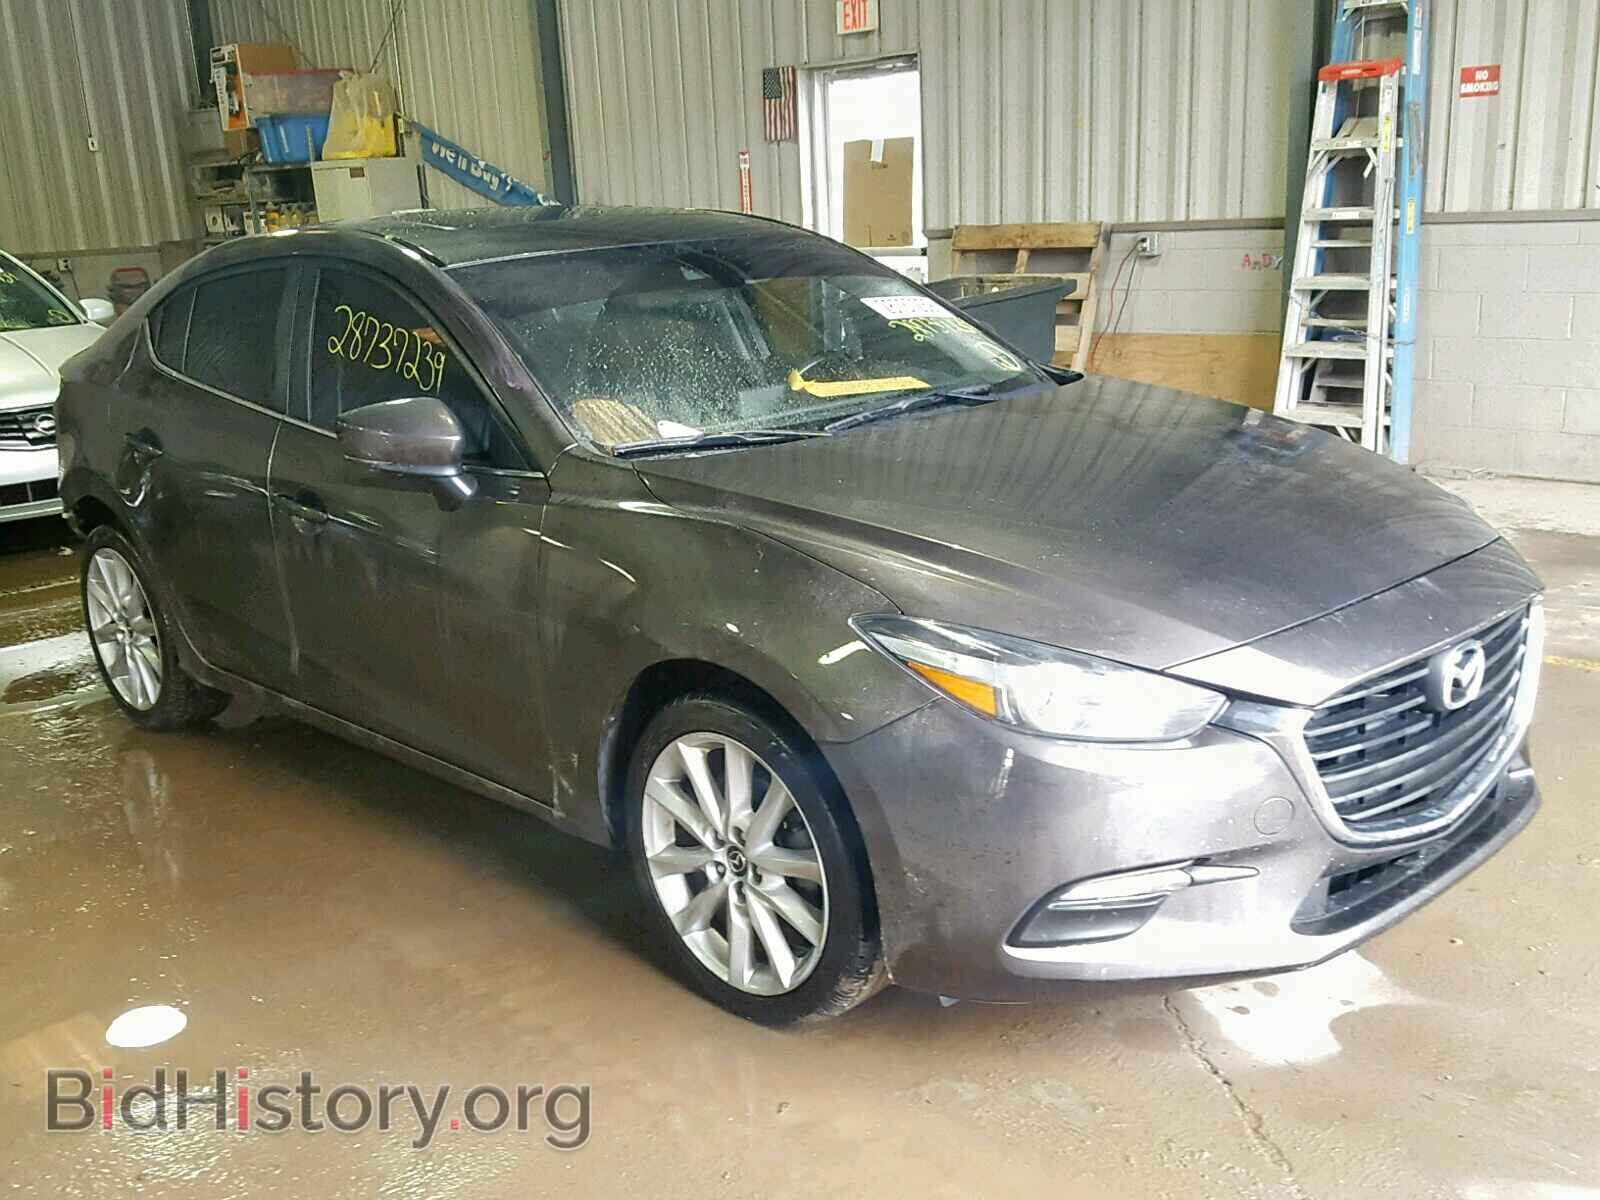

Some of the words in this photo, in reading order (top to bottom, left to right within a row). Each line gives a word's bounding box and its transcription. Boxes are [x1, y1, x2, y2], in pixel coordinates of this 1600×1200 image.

[842, 0, 869, 31] EXIT
[1475, 70, 1489, 81] NO
[327, 305, 446, 395] 28737239
